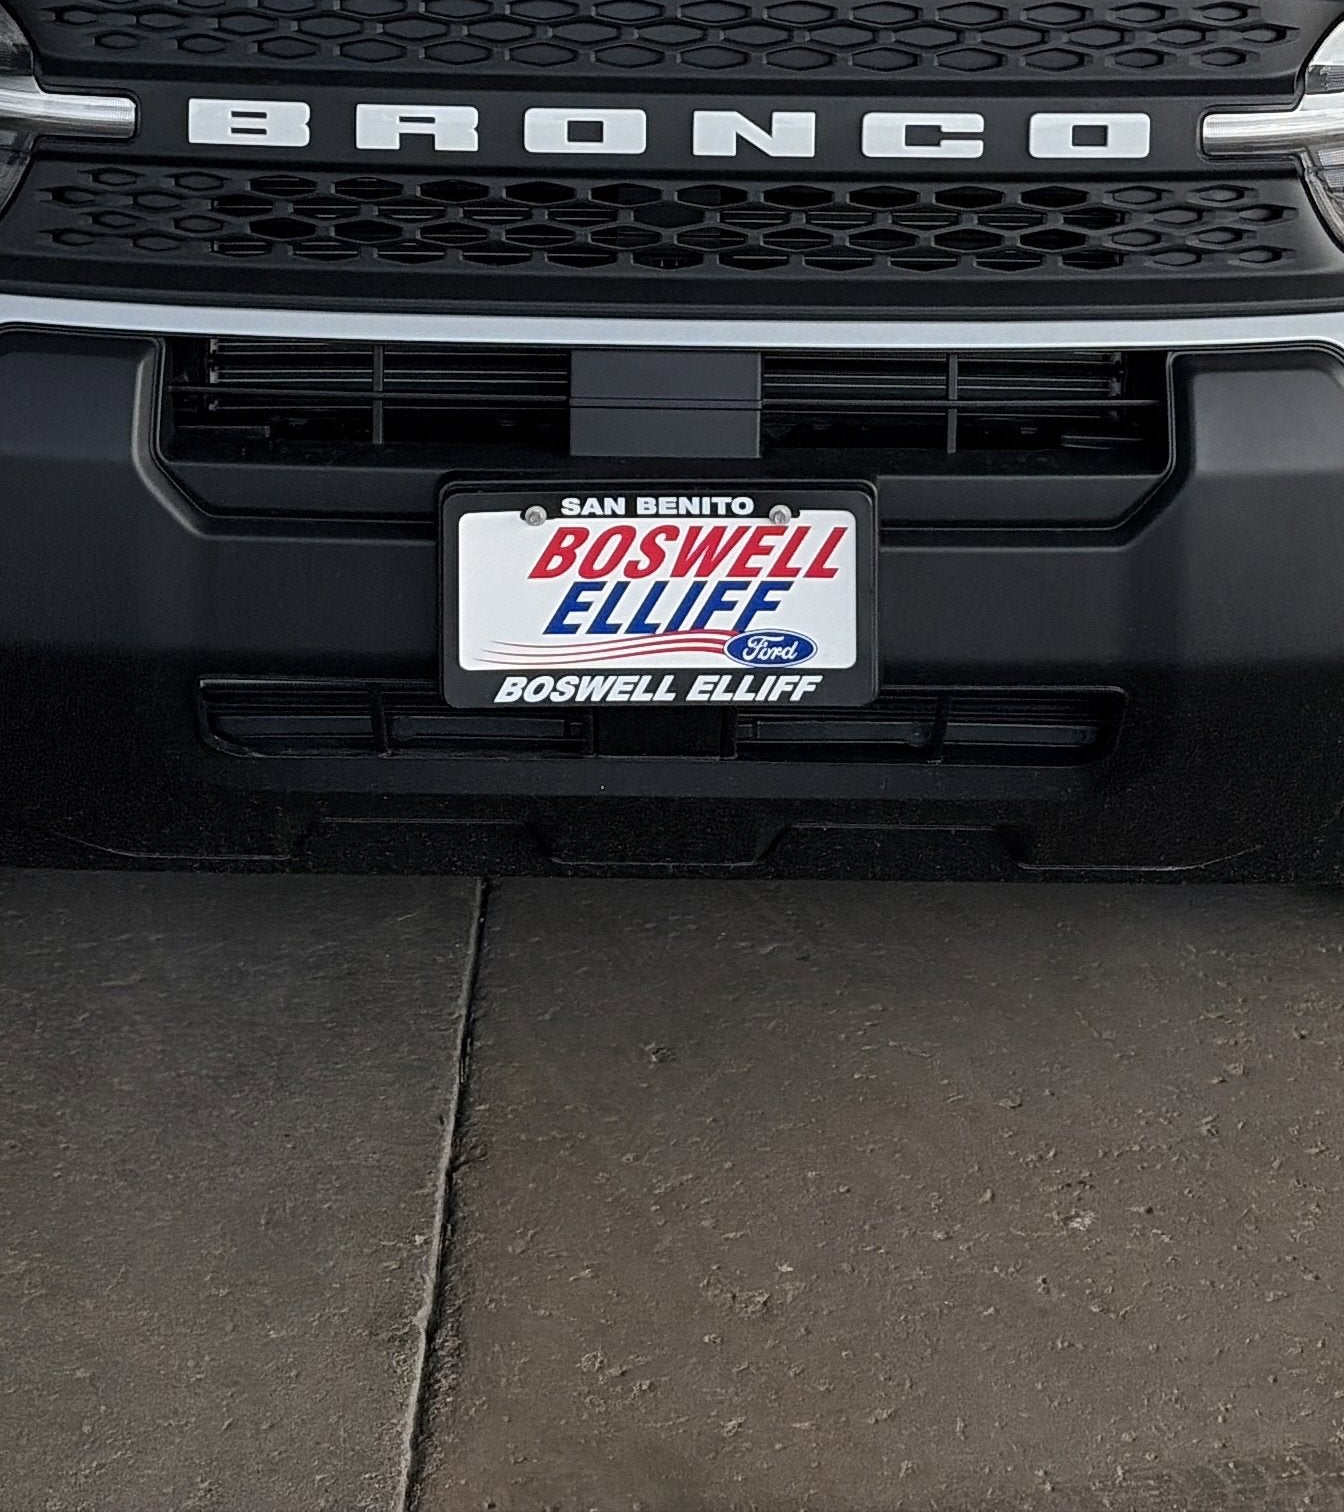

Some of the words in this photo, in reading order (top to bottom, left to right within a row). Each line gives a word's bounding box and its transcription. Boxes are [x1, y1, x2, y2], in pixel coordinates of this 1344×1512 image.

[187, 97, 1151, 159] BRONCO
[560, 496, 626, 516] SAN
[636, 496, 755, 516] BENITO
[527, 525, 848, 580] BOSWELL
[542, 580, 793, 635] ELLIFF
[741, 635, 798, 662] Ford
[494, 675, 677, 703] BOSWELL
[685, 675, 823, 702] ELLIFF
